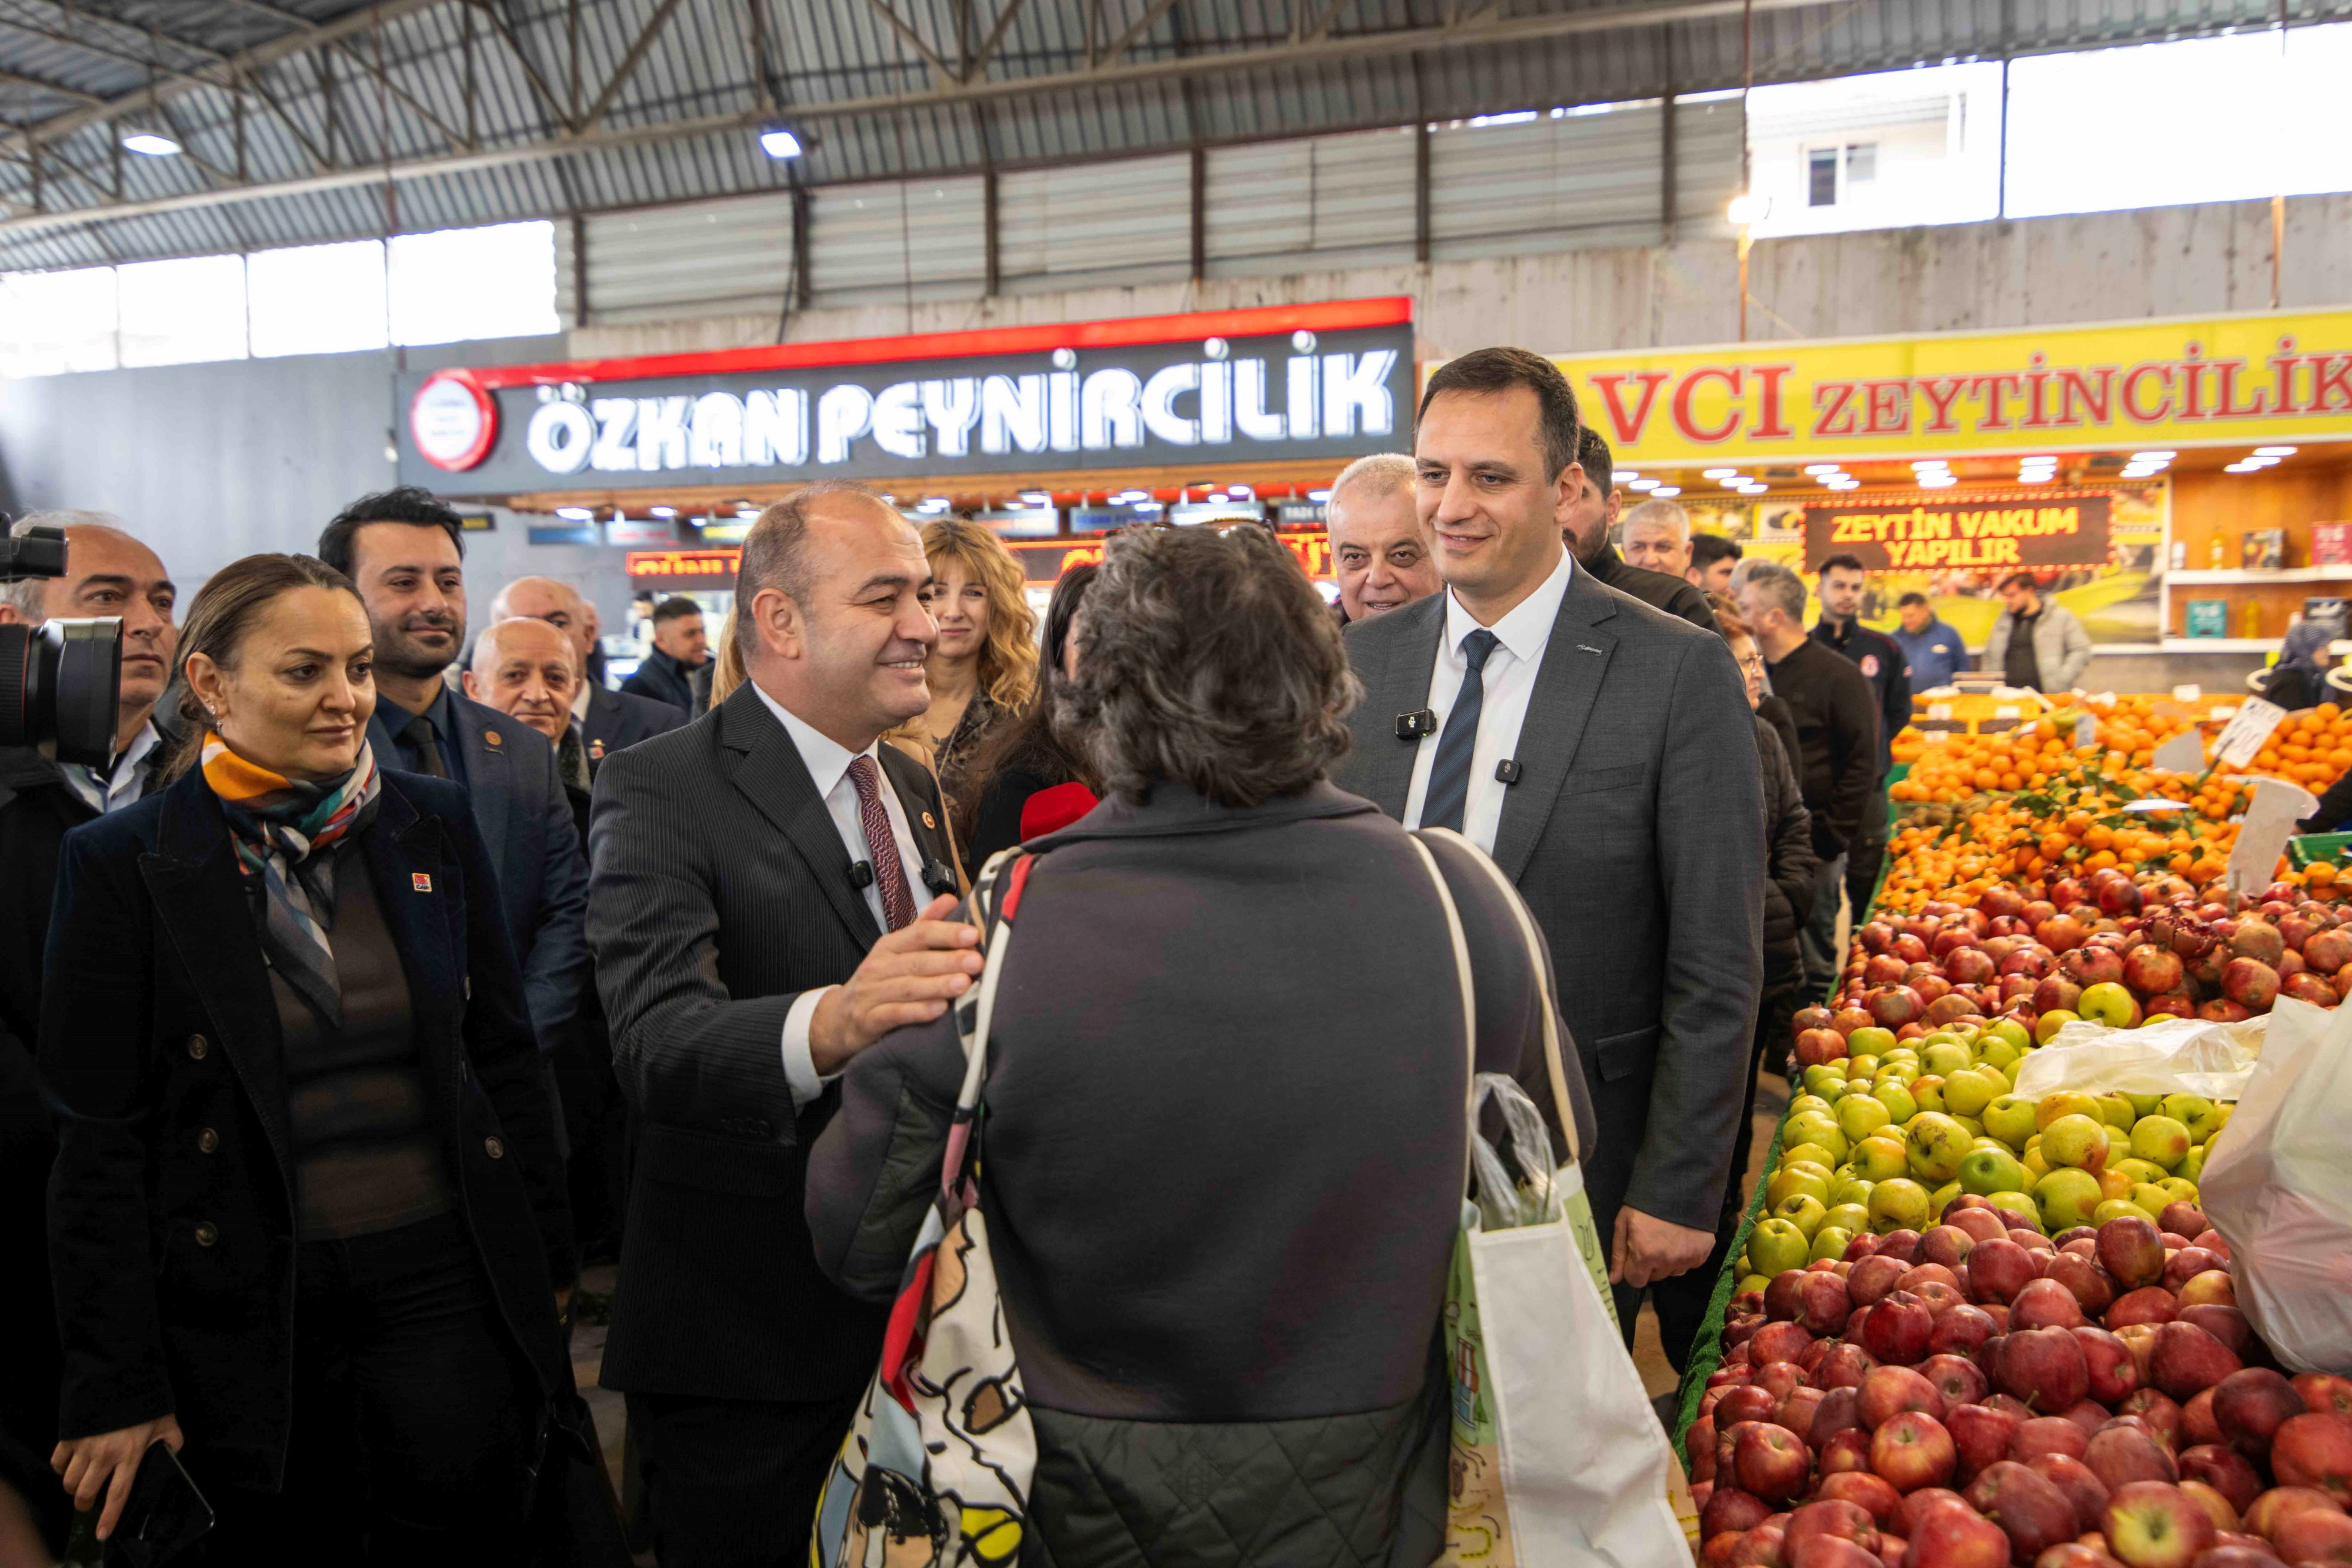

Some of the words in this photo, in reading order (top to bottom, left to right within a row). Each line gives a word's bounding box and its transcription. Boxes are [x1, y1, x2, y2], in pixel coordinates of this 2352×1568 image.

[527, 382, 809, 474] ÖZKAN
[818, 330, 1399, 463] PEYNİRCİLİK
[1580, 361, 1796, 448] VCI
[1812, 335, 2352, 439] ZEYTİNCİLİK
[1830, 507, 1952, 543] ZEYTİN
[1957, 506, 2079, 538] VAKUM
[1883, 537, 2021, 568] YAPILIR
